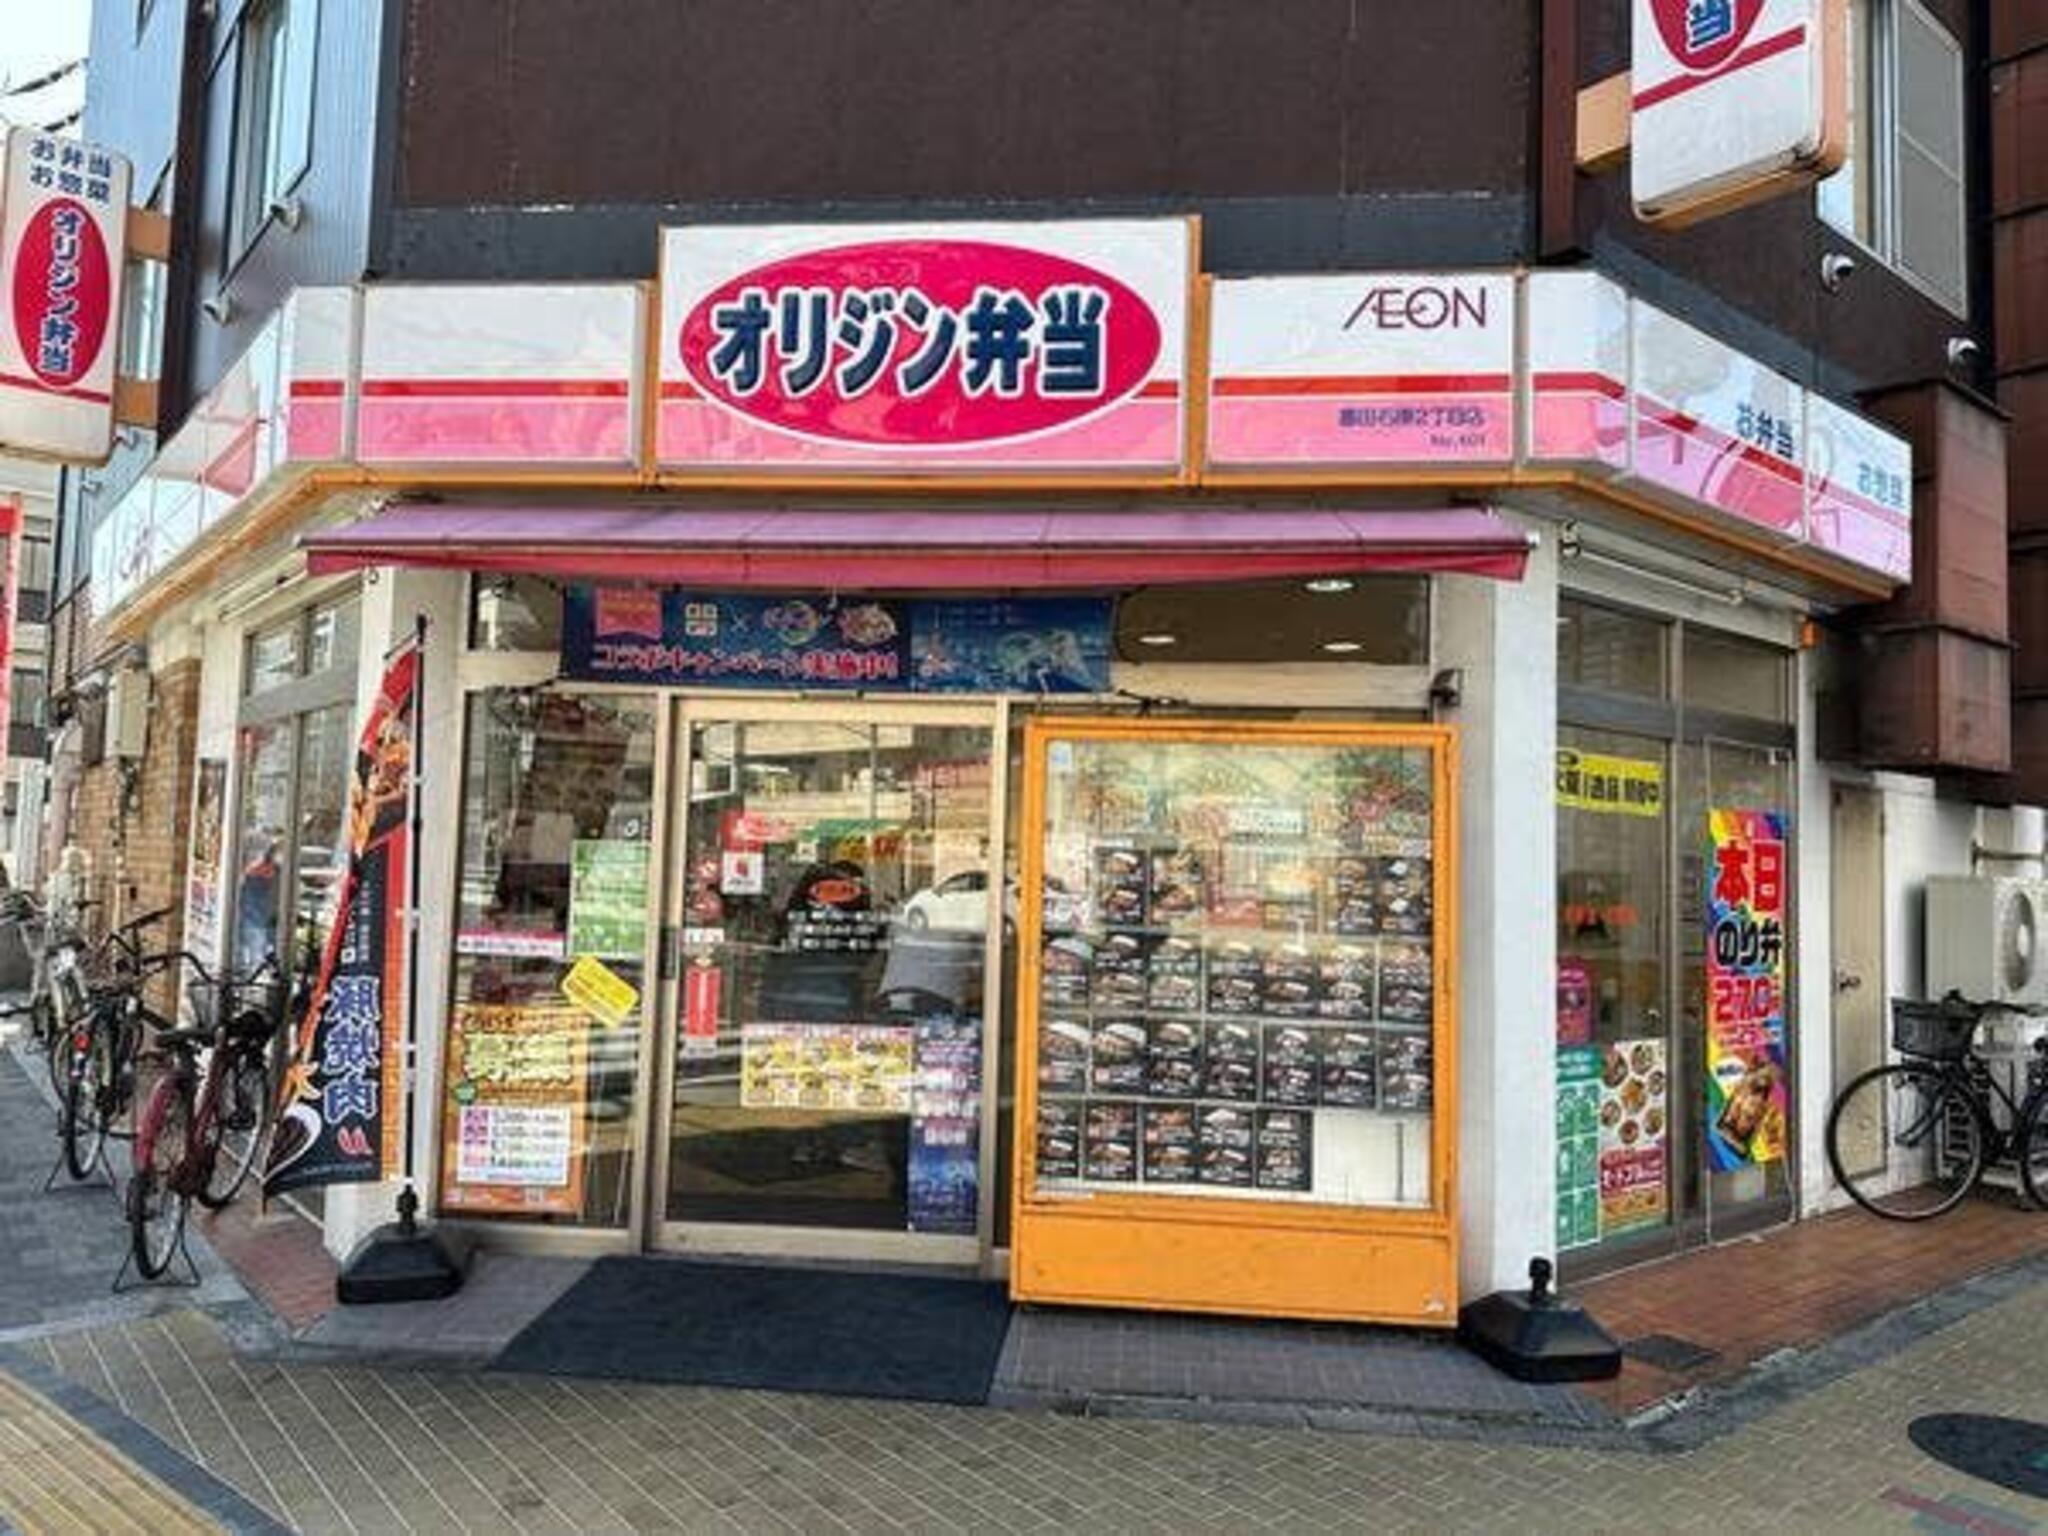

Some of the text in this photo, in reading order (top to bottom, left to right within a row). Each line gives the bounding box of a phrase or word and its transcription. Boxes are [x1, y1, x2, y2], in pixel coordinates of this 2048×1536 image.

[31, 139, 110, 178] お弁当
[41, 211, 80, 371] オリジン弁当
[710, 292, 1104, 396] オリジン弁当
[1736, 402, 1794, 458] お弁当
[1715, 839, 1782, 912] 本日
[1715, 917, 1782, 967] のり弁
